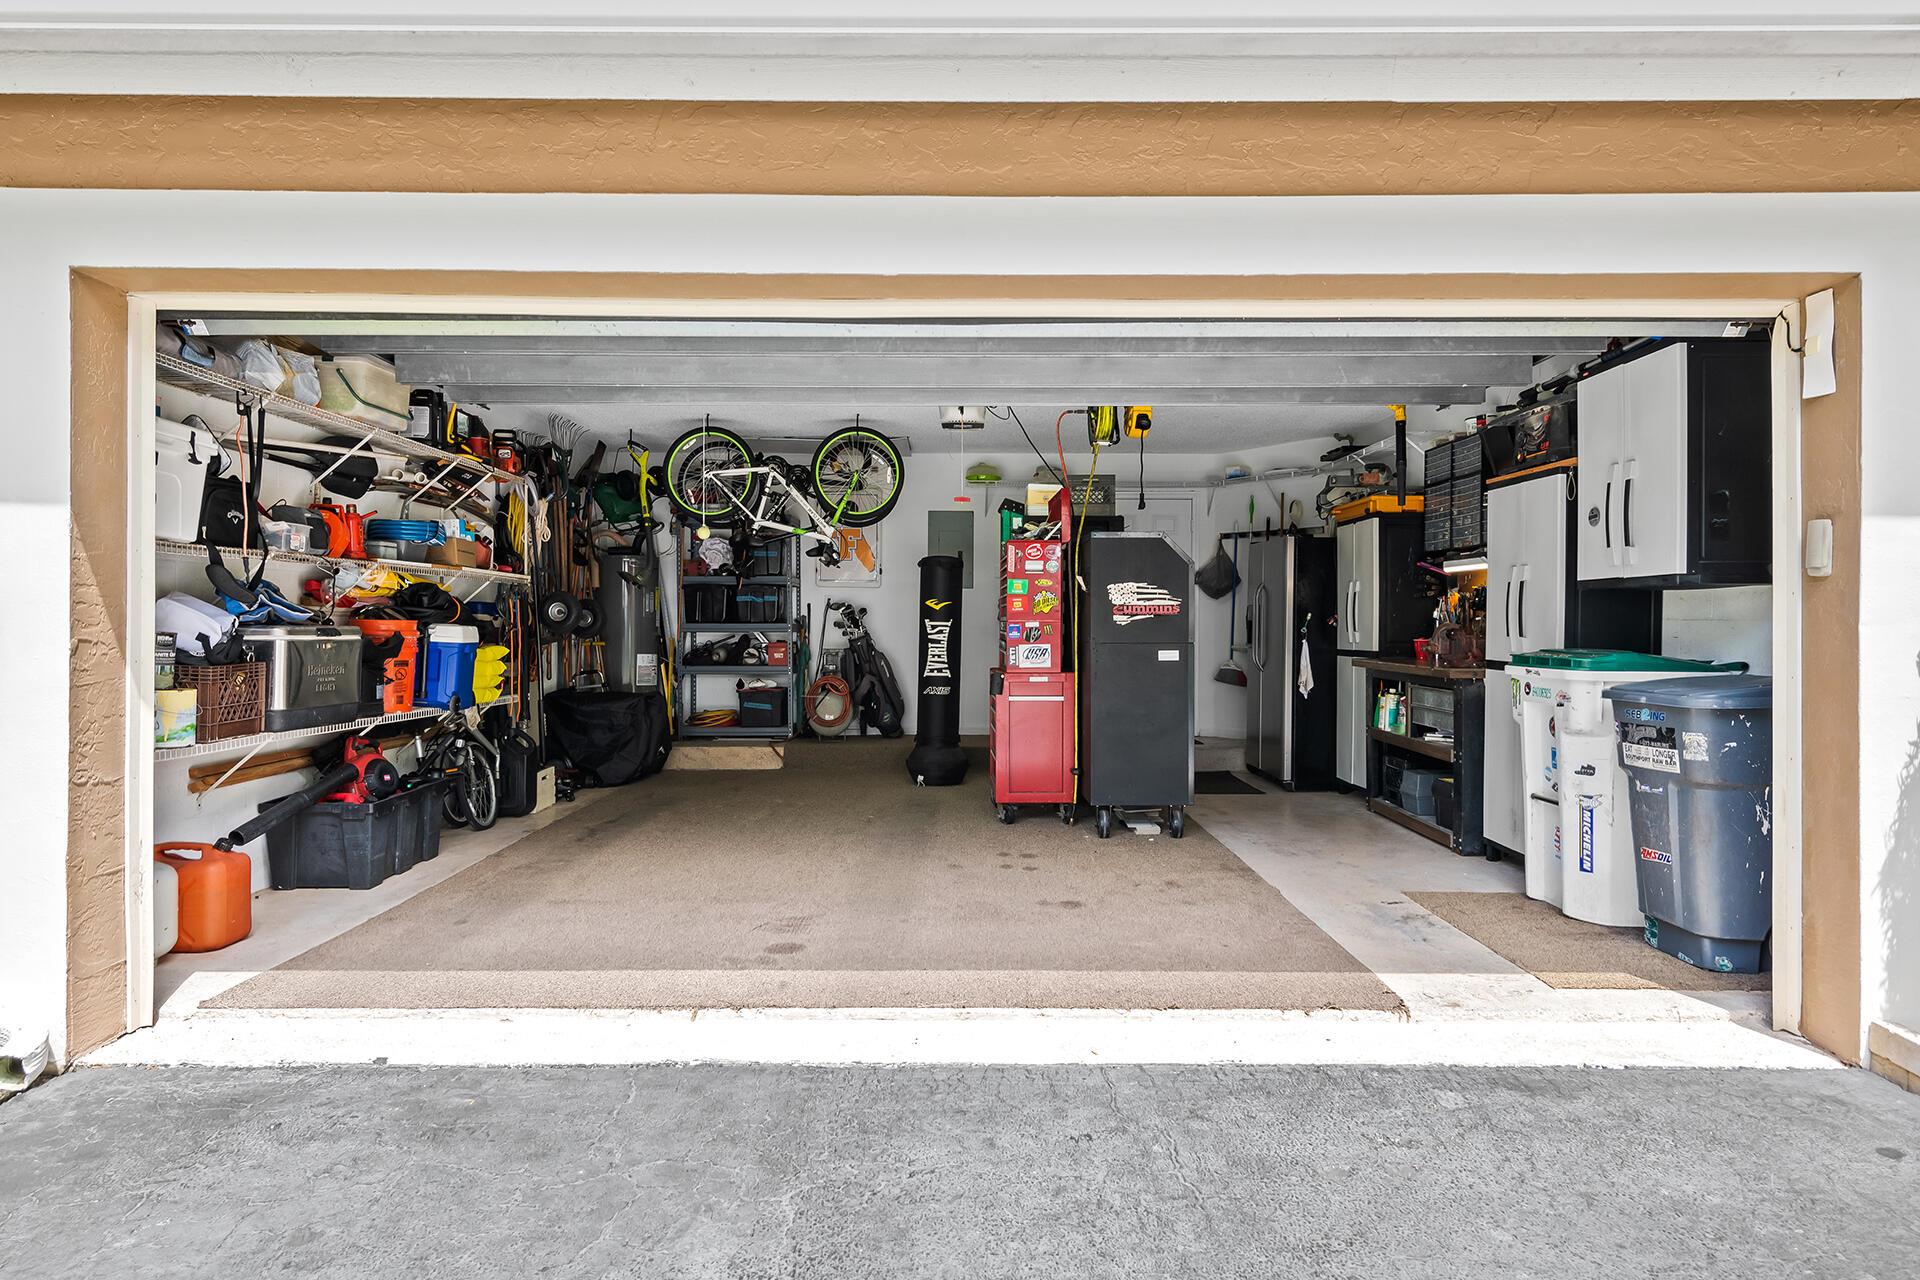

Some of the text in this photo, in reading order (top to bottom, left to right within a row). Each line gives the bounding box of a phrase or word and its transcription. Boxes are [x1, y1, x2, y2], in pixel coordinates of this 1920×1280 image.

[1113, 605, 1180, 615] Cummins
[923, 619, 953, 678] EVERLAST
[1025, 648, 1048, 660] USA
[307, 663, 345, 677] Heineken
[923, 686, 951, 695] AXIS
[1651, 748, 1677, 760] LONGER
[1582, 807, 1592, 872] MICHELIN
[1640, 847, 1671, 864] AMSOIL
